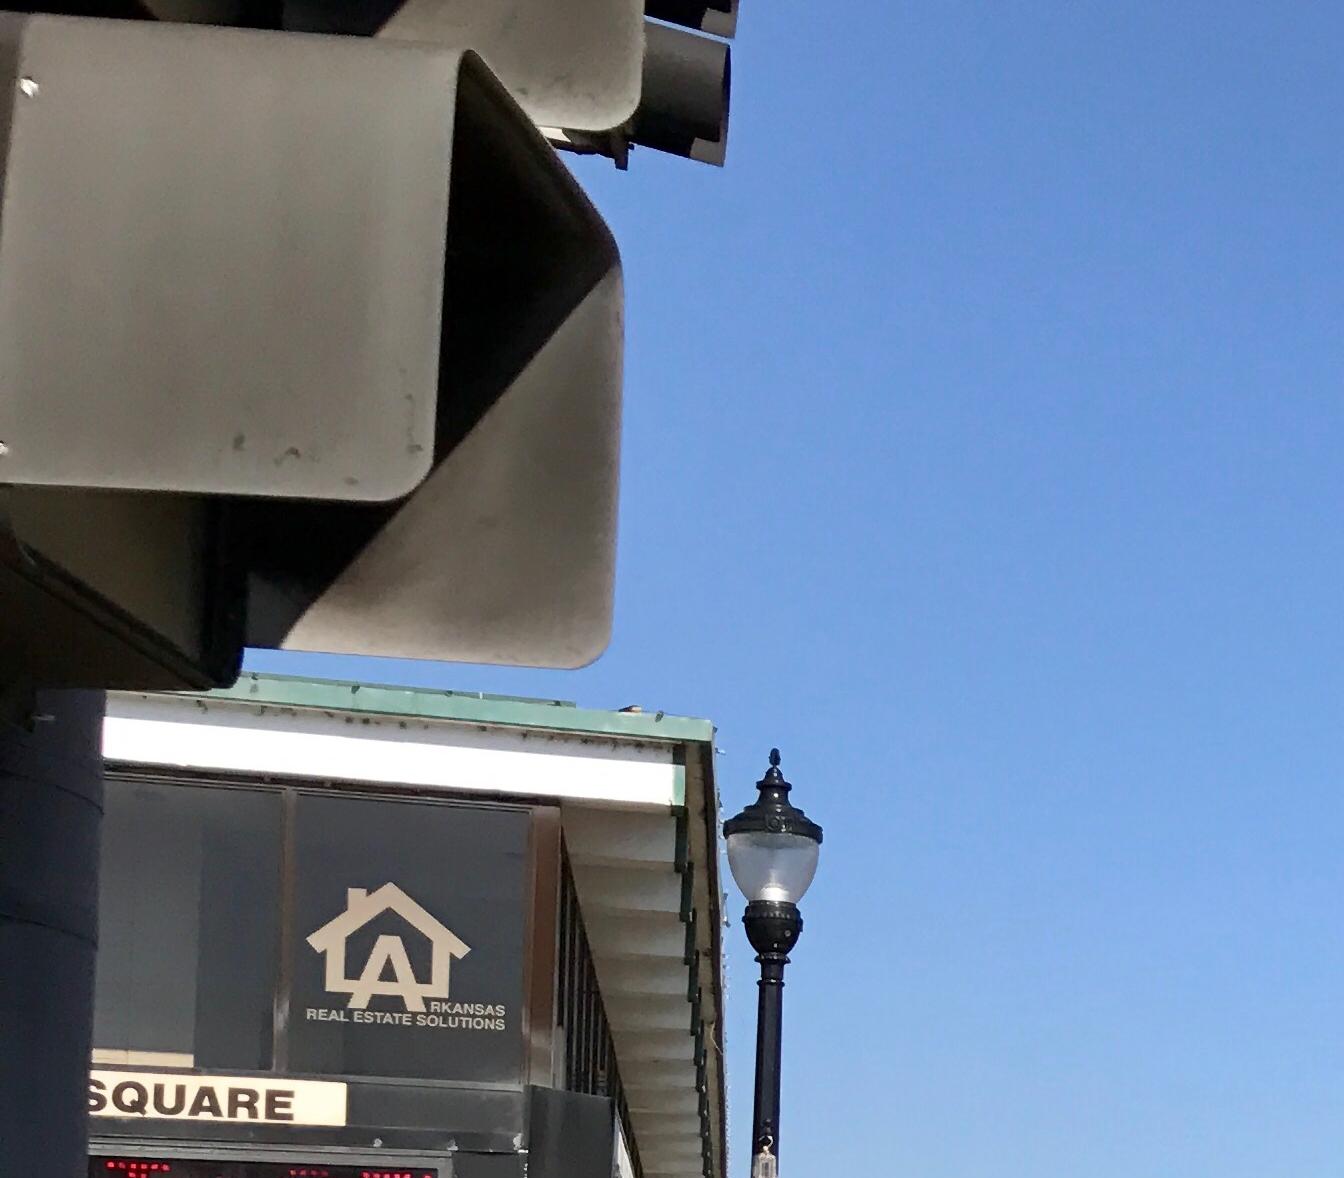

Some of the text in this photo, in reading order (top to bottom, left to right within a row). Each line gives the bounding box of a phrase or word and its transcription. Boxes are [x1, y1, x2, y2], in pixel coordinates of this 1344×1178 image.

[306, 1008, 506, 1031] REAL ESTATE SOLUTIONS
